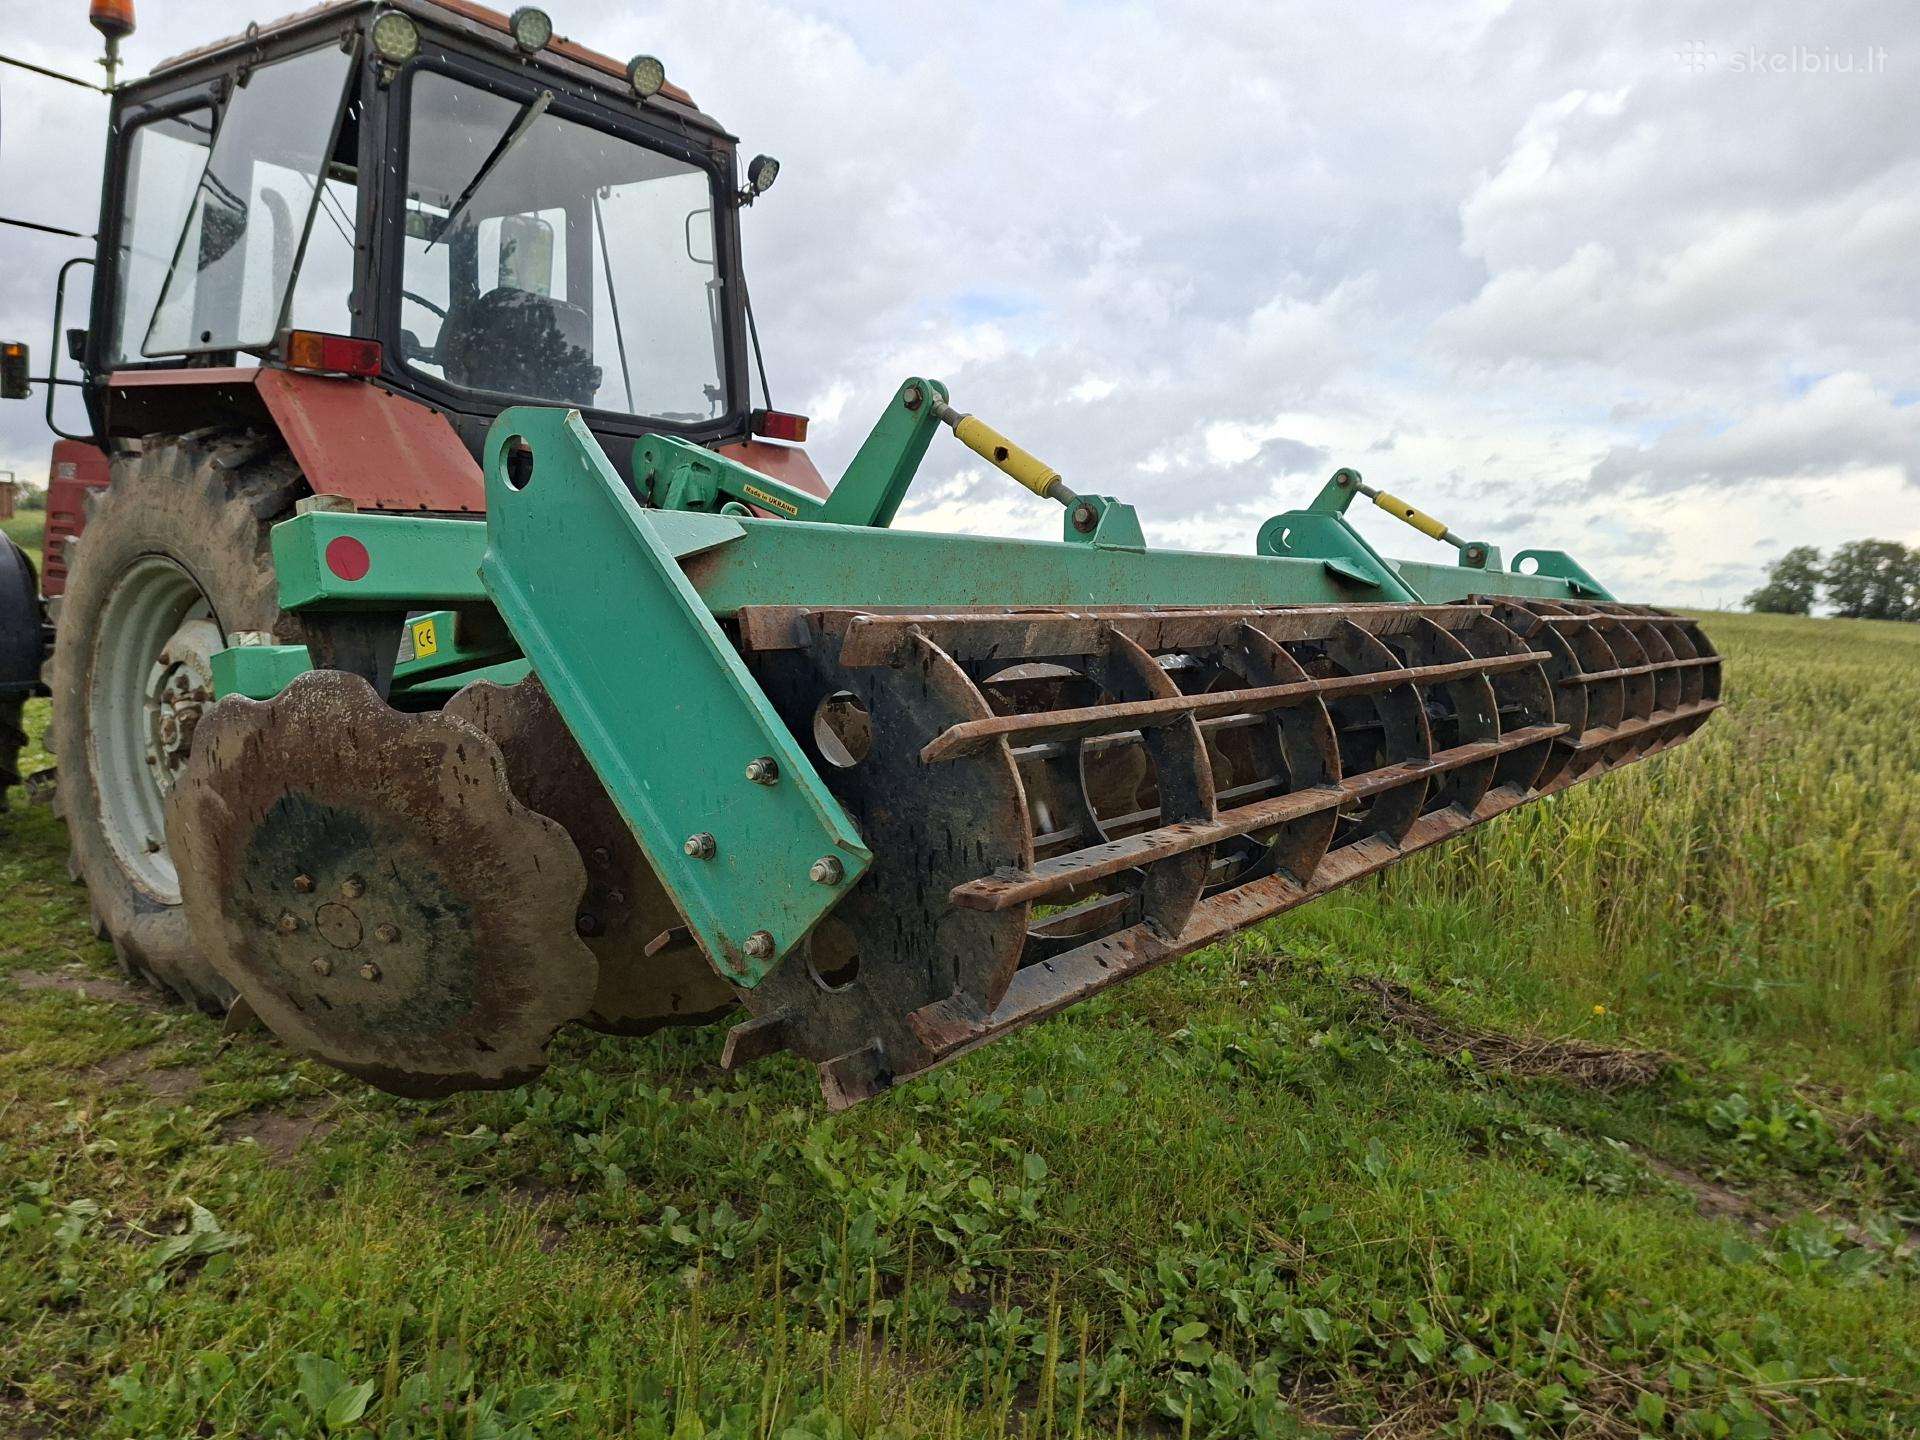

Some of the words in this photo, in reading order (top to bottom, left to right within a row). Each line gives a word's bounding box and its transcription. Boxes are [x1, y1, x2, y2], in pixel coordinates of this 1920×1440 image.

[746, 486, 761, 498] Made
[768, 496, 796, 514] UKRAINE
[418, 628, 433, 648] CE
